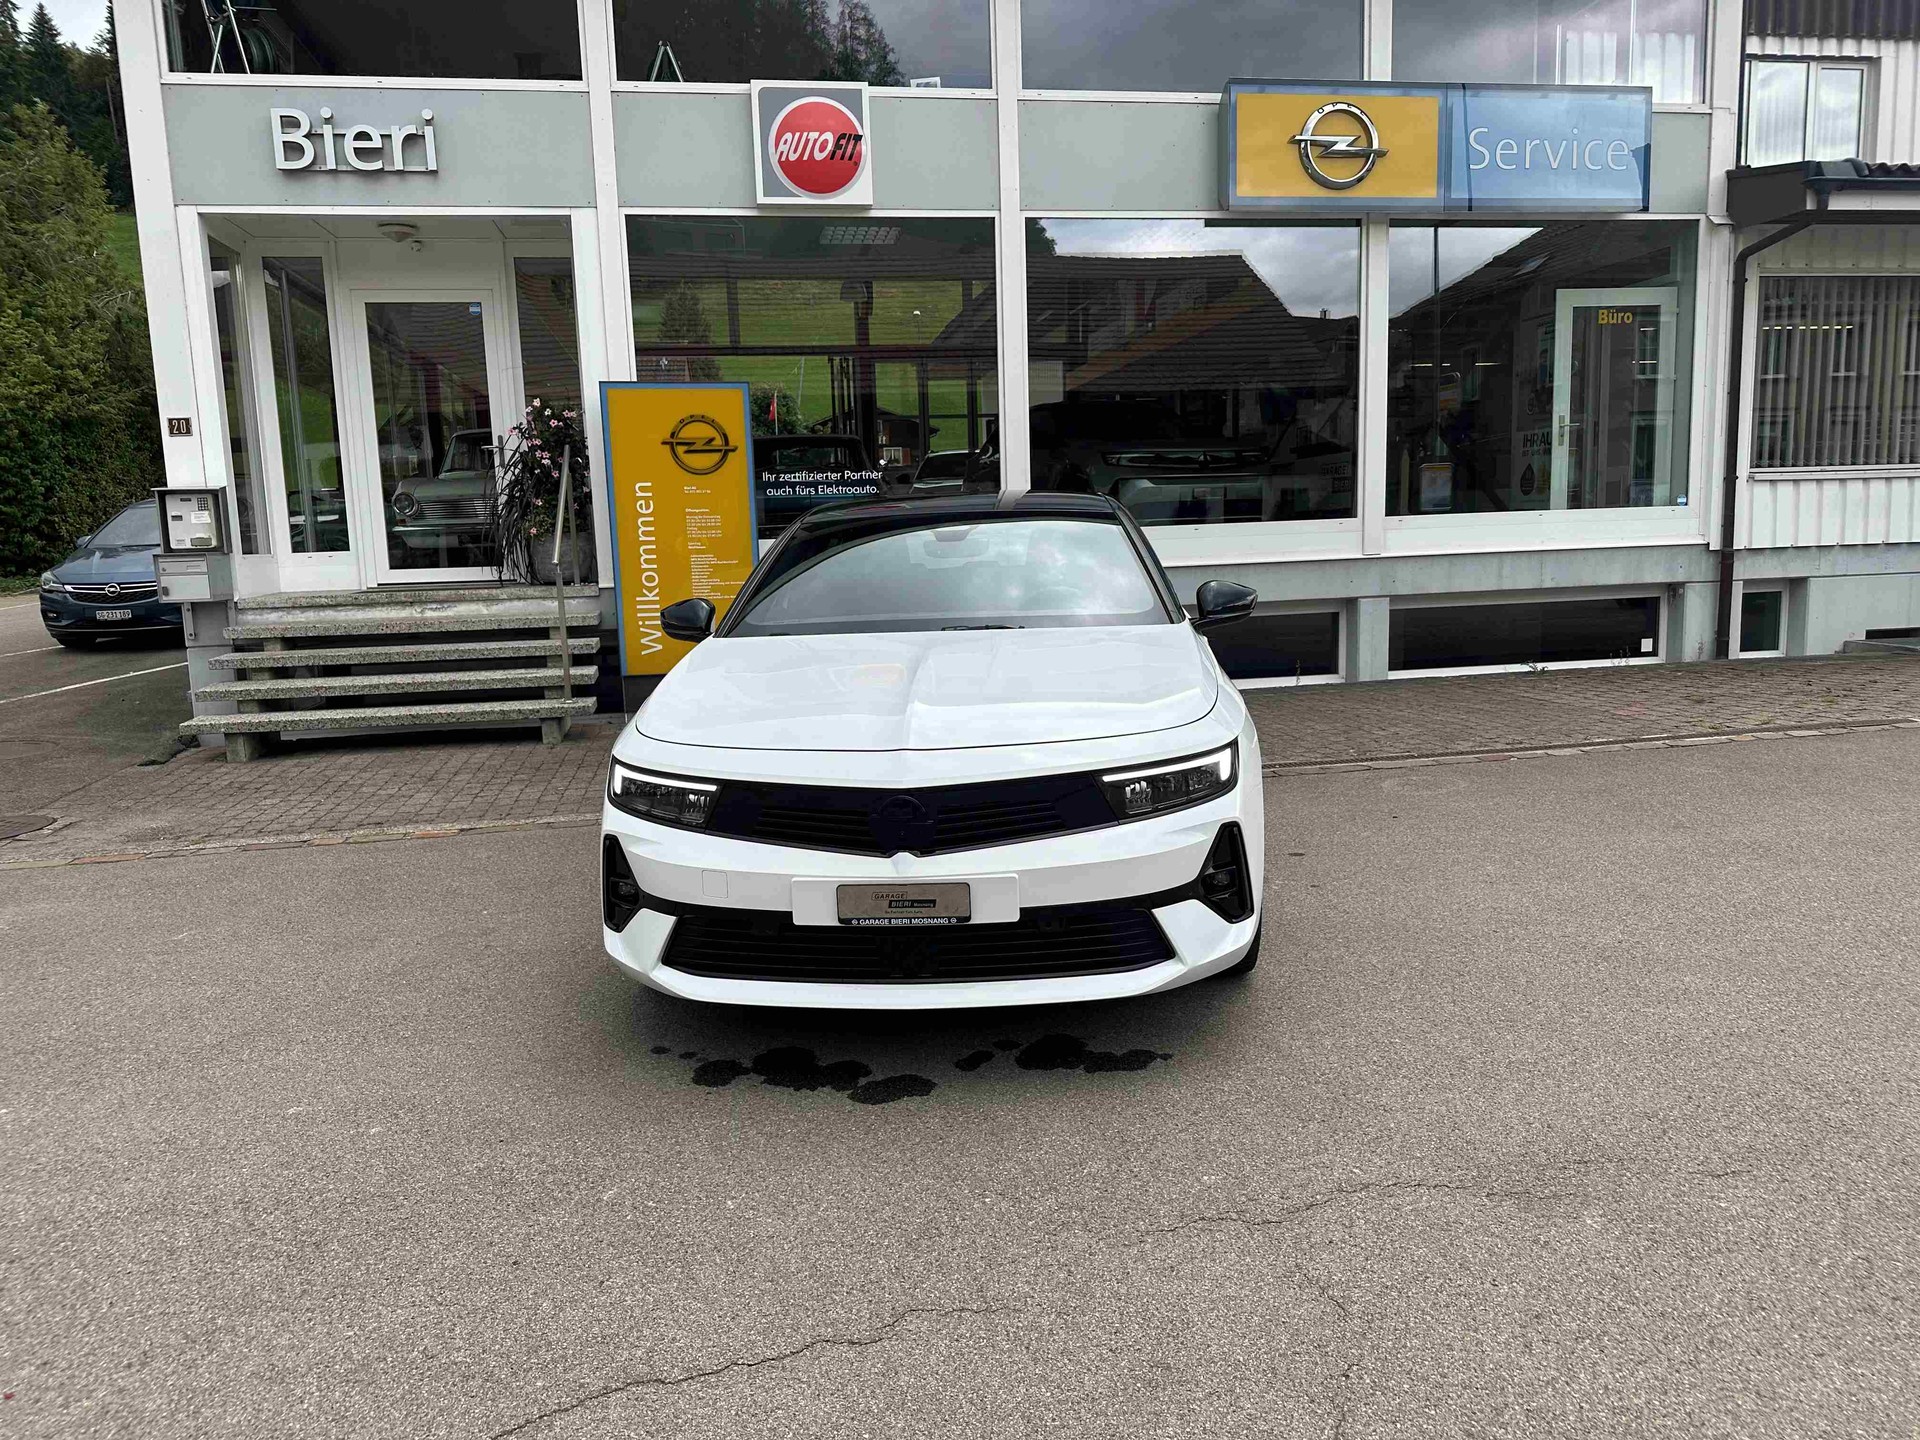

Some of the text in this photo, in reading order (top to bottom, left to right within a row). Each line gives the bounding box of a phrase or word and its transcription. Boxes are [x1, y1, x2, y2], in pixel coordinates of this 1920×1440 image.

[270, 106, 438, 171] Bieri
[776, 131, 863, 162] AUTOFIT
[1468, 126, 1629, 171] Service
[1598, 309, 1633, 324] Büro
[172, 419, 187, 434] 20
[762, 470, 882, 482] Ihr zertifizierter Partner
[766, 484, 880, 496] auch fürs Elektroauto.
[635, 481, 663, 655] Willkommen
